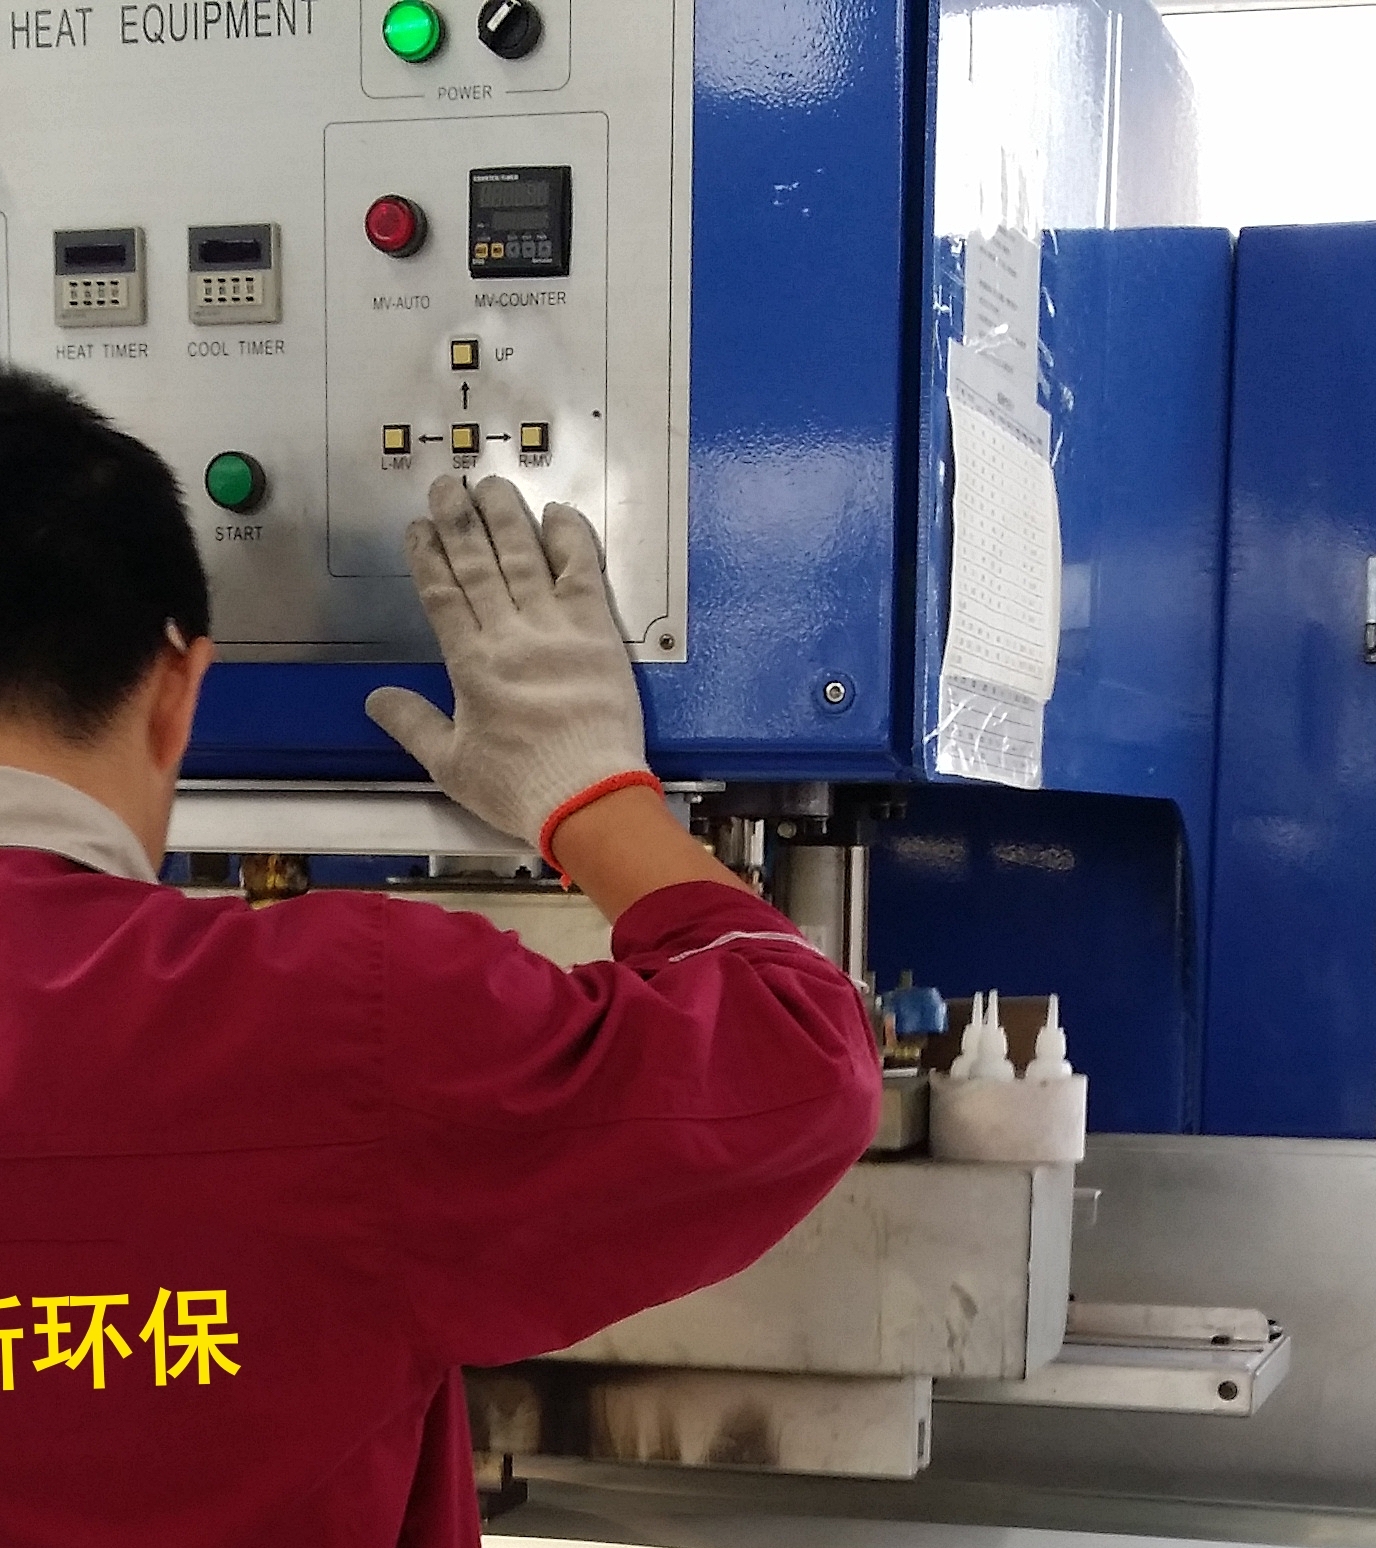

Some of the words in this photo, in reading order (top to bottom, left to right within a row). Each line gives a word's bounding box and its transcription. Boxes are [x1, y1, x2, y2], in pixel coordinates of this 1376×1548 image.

[10, 8, 93, 49] HEAT
[121, 0, 316, 45] EQUIPMENT
[437, 85, 493, 101] POWER
[373, 295, 431, 311] MV-AUTO
[474, 291, 567, 308] MV-COUNTER
[56, 345, 94, 360] HEAT
[103, 343, 149, 358] TIMER
[187, 341, 229, 357] COOL
[239, 339, 285, 356] TIMER
[495, 346, 514, 362] UP
[381, 456, 413, 470] L-MV
[452, 454, 478, 469] SET
[518, 453, 553, 467] R-MV
[214, 525, 263, 542] START
